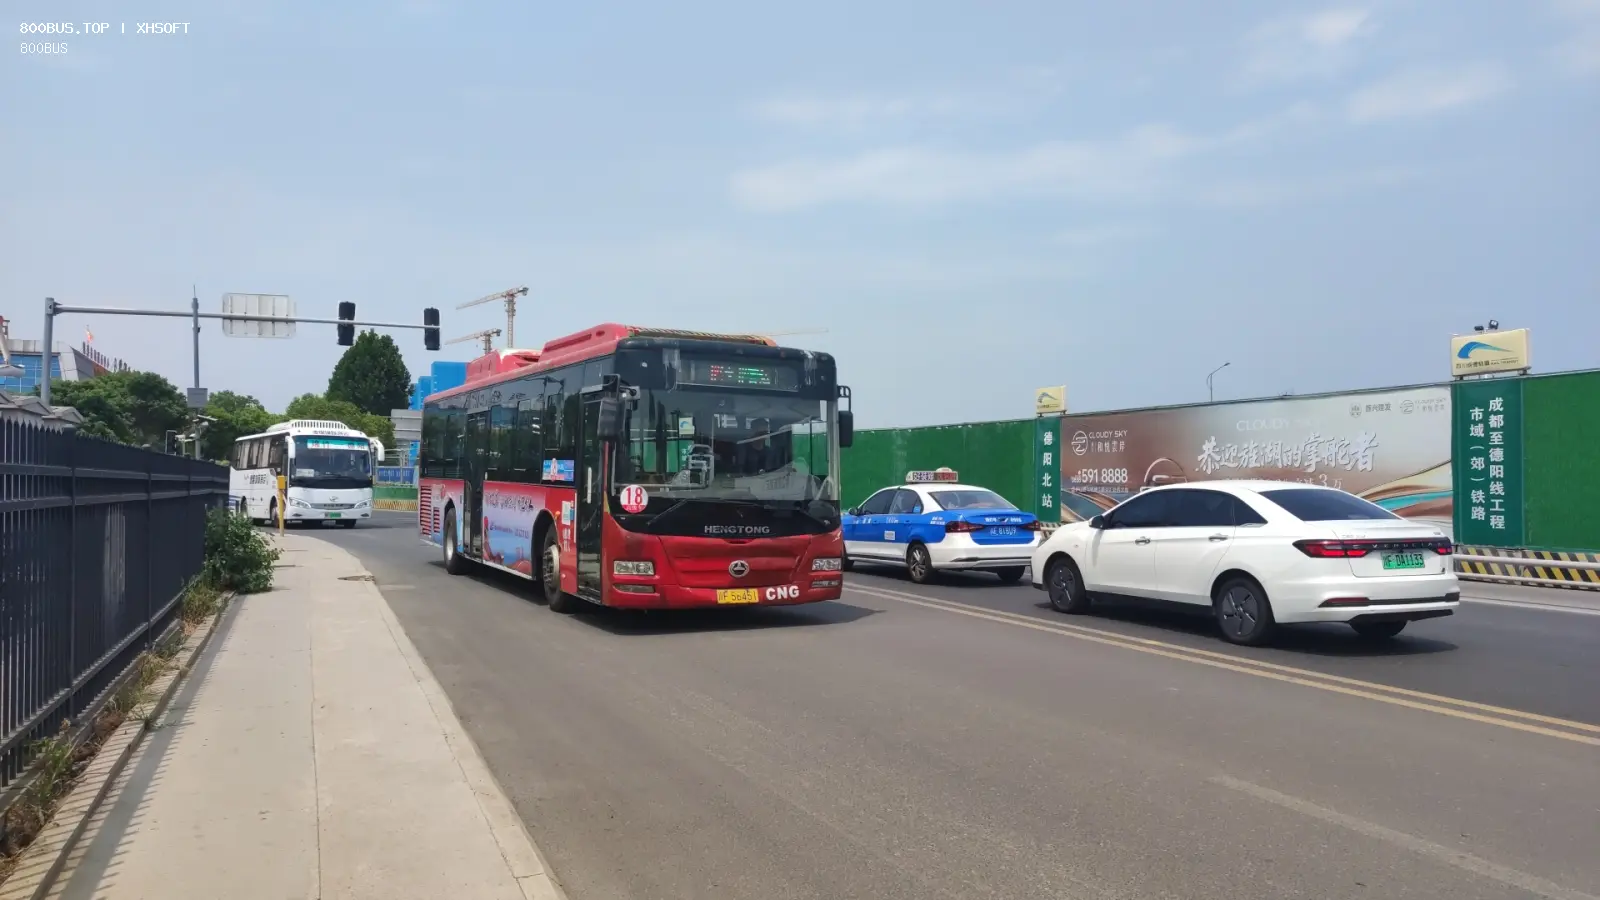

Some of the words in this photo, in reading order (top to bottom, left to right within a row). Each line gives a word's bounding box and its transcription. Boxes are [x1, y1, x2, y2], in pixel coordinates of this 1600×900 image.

[1236, 418, 1290, 432] CLOUDY
[1088, 430, 1113, 439] CLOUDY
[1114, 429, 1128, 438] SKY
[1041, 431, 1053, 508] 德阳北站
[1488, 396, 1506, 530] 成都至德阳线工程
[1081, 468, 1099, 484] 591
[1101, 467, 1128, 484] 8888
[626, 487, 643, 505] 18
[703, 524, 771, 535] HENGTONG
[1396, 553, 1424, 567] DA1133
[765, 585, 800, 601] CNG
